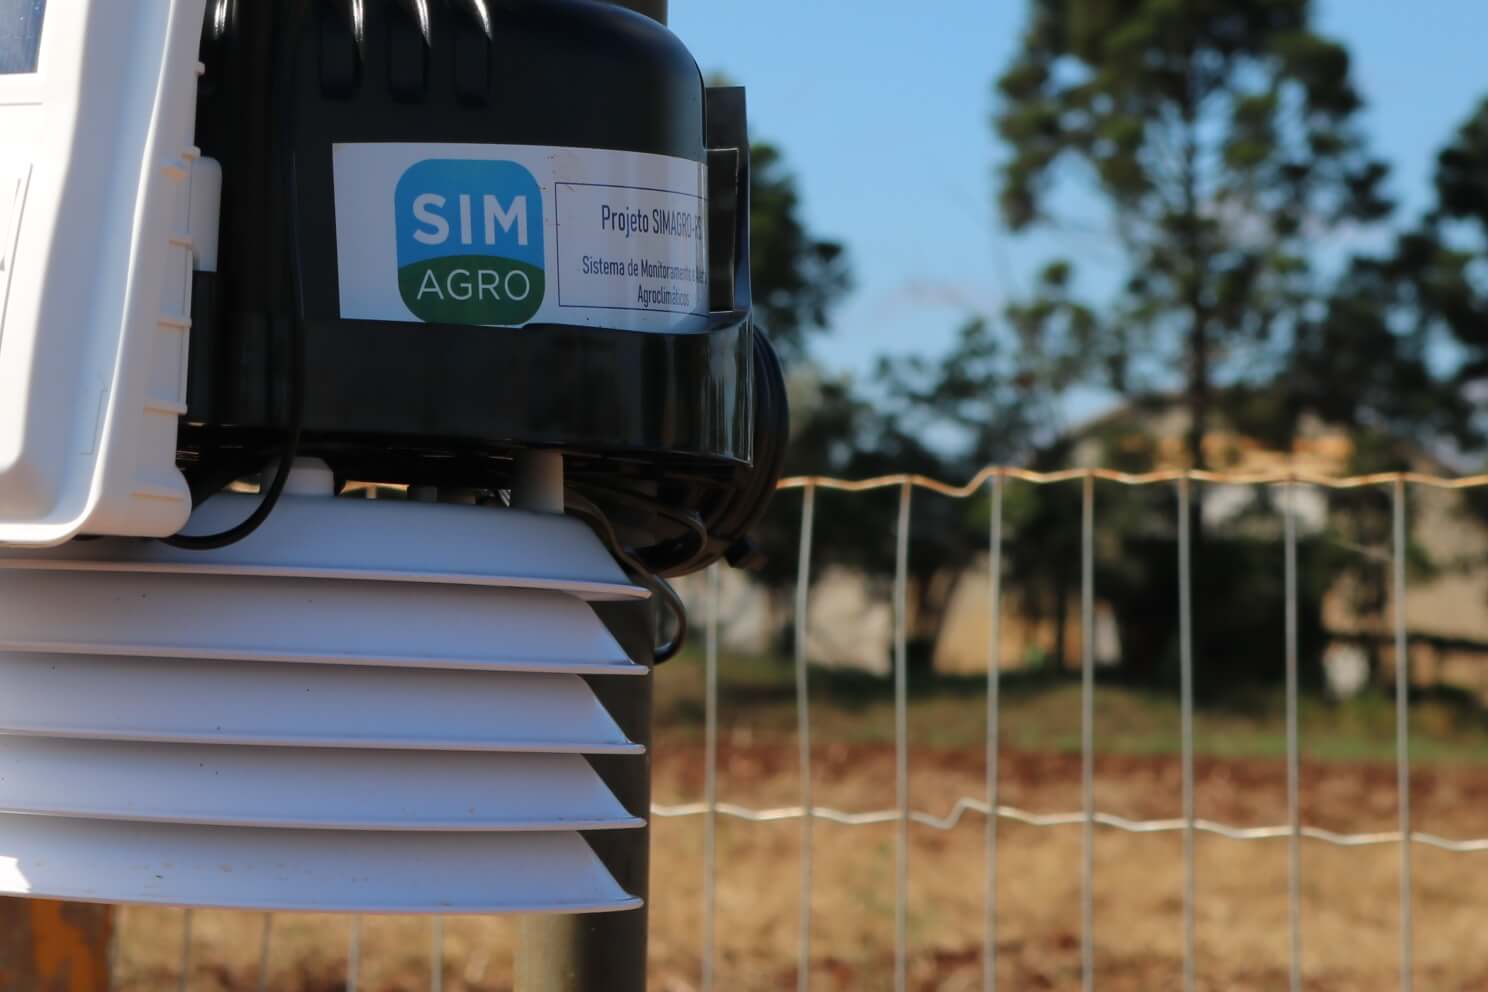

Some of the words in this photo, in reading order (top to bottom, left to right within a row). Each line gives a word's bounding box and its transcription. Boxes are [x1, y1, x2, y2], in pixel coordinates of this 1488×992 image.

[412, 193, 529, 246] SIM
[601, 204, 649, 238] Projeto
[582, 255, 625, 277] Sistema
[627, 258, 639, 277] de
[417, 269, 531, 302] AGRO
